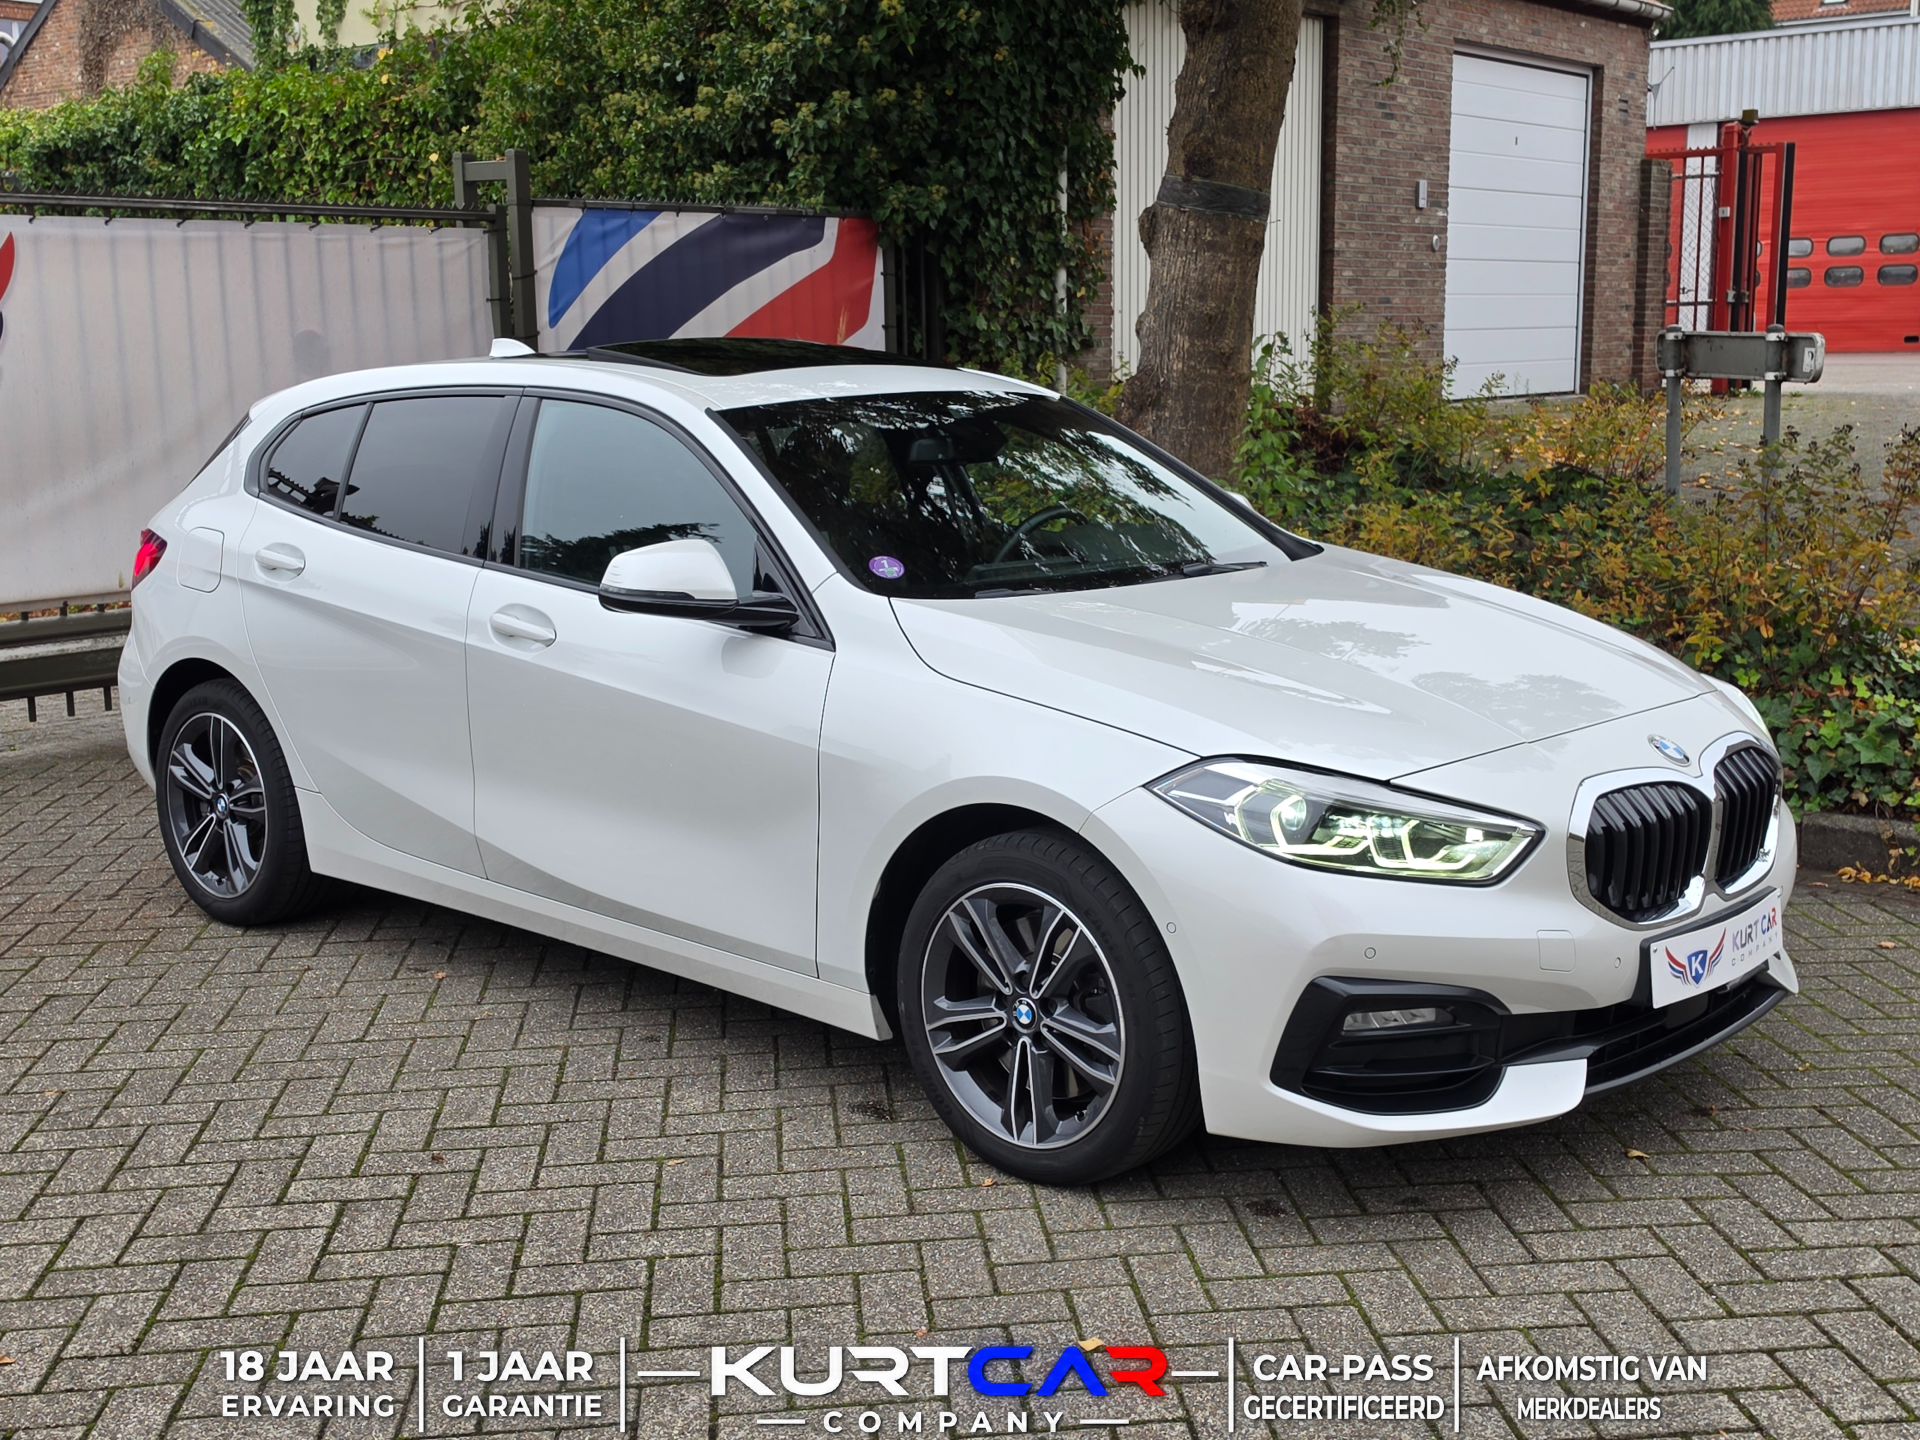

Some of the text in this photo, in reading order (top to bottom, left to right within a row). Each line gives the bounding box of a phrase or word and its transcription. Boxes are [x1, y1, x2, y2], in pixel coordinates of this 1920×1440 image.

[1731, 906, 1778, 953] KURT CAR
[1690, 952, 1705, 977] K
[1731, 931, 1778, 966] COMPANY
